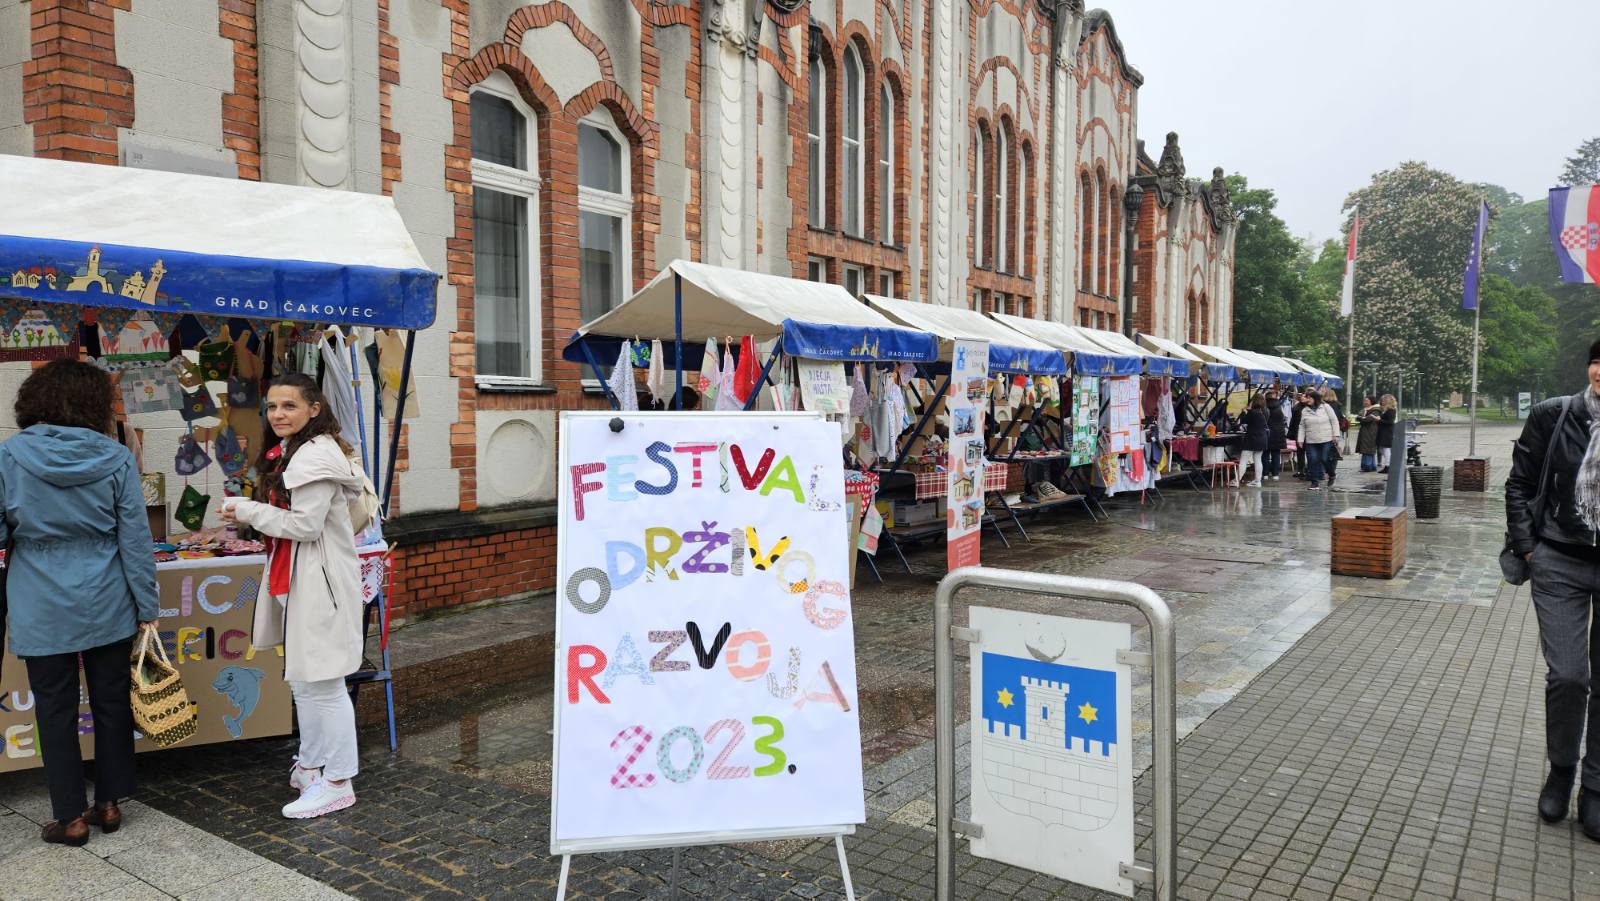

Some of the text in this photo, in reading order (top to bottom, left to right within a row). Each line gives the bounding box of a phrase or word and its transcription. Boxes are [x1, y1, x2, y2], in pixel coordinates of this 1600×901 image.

[215, 296, 373, 318] GRAD ČAKOVEC
[570, 441, 842, 521] FESTIVAL
[566, 521, 848, 630] ODRŽIVOG
[567, 621, 850, 712] RAZVOJA
[610, 715, 797, 789] 2023.
